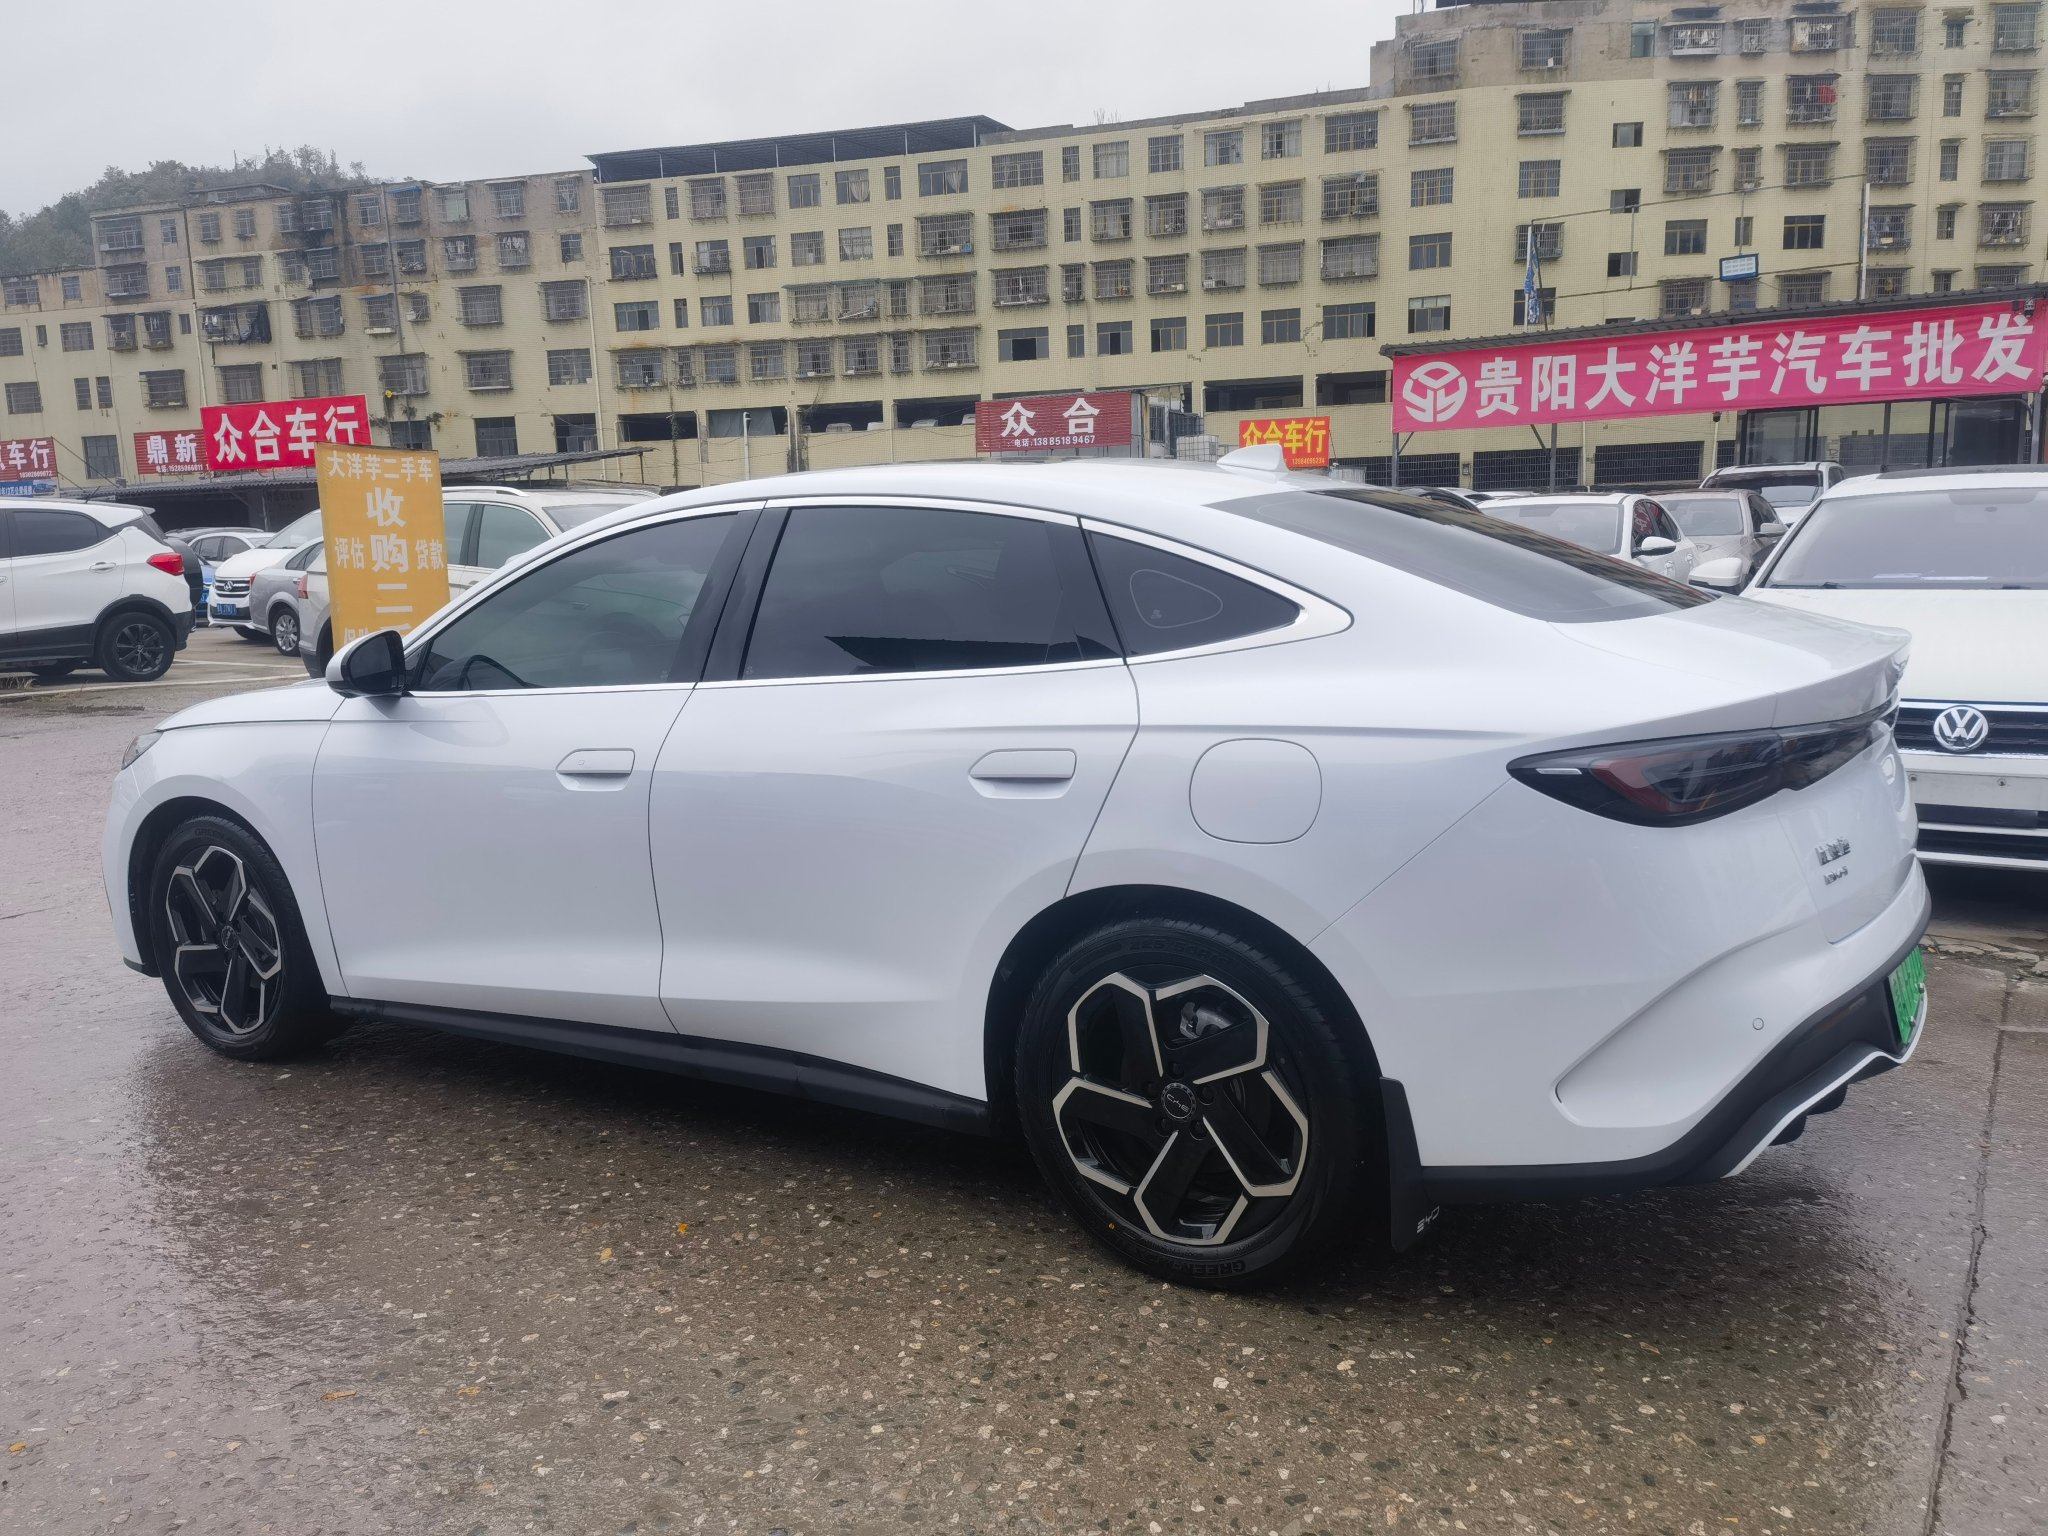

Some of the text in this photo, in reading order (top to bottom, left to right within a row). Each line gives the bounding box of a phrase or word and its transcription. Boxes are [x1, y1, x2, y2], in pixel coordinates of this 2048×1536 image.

[1475, 313, 2035, 418] 贵阳大洋芋汽车批发
[213, 405, 359, 463] 众合车行
[1000, 398, 1100, 437] 众合
[146, 433, 197, 464] 鼎新
[1242, 419, 1327, 454] 众合车行
[327, 450, 433, 483] 大洋芋二手车
[335, 537, 365, 569] 评估
[415, 539, 444, 570] 贷款
